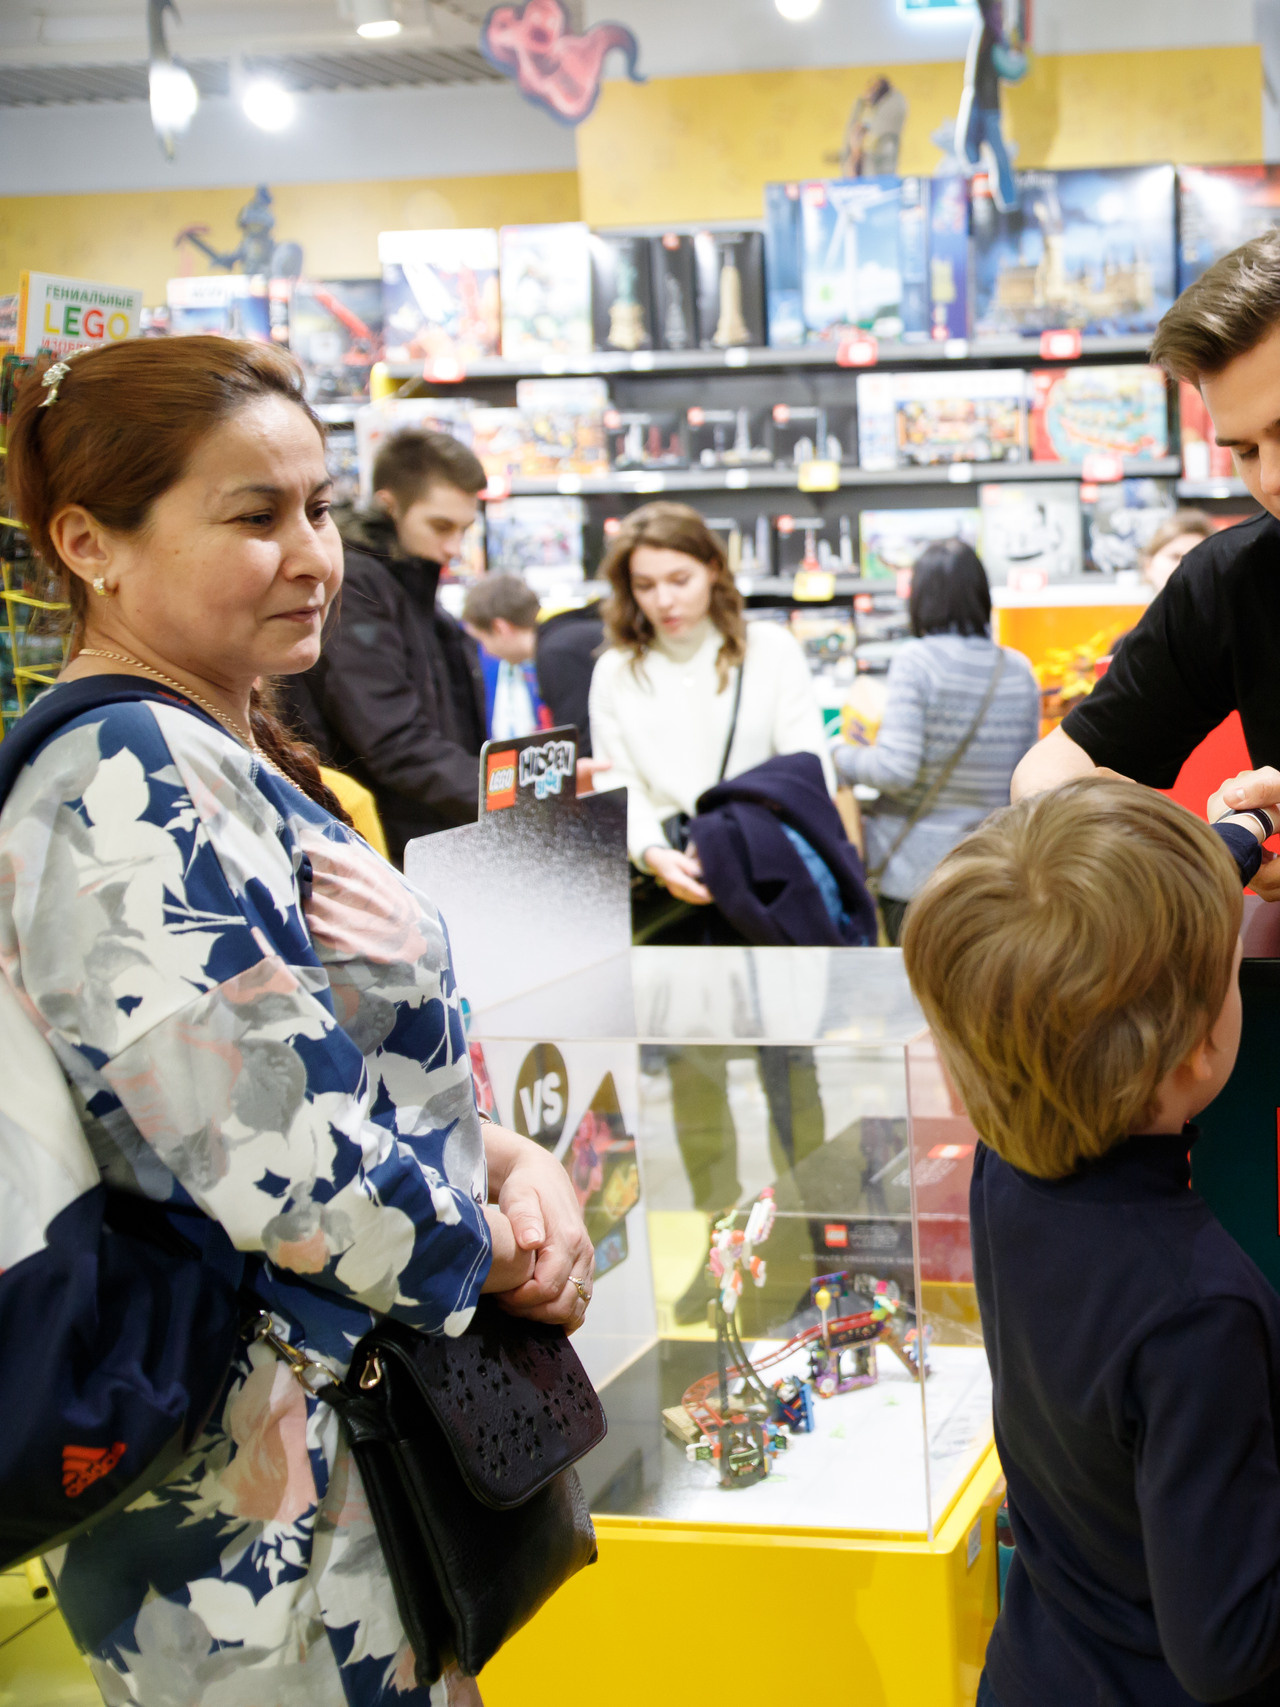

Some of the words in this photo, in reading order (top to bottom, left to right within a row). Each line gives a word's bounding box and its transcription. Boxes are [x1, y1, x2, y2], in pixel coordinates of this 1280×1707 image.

[46, 284, 134, 308] ГЕНИАЛЬНЫЕ
[44, 302, 129, 340] LEGO
[488, 767, 515, 793] LEGO
[519, 1072, 563, 1137] VS
